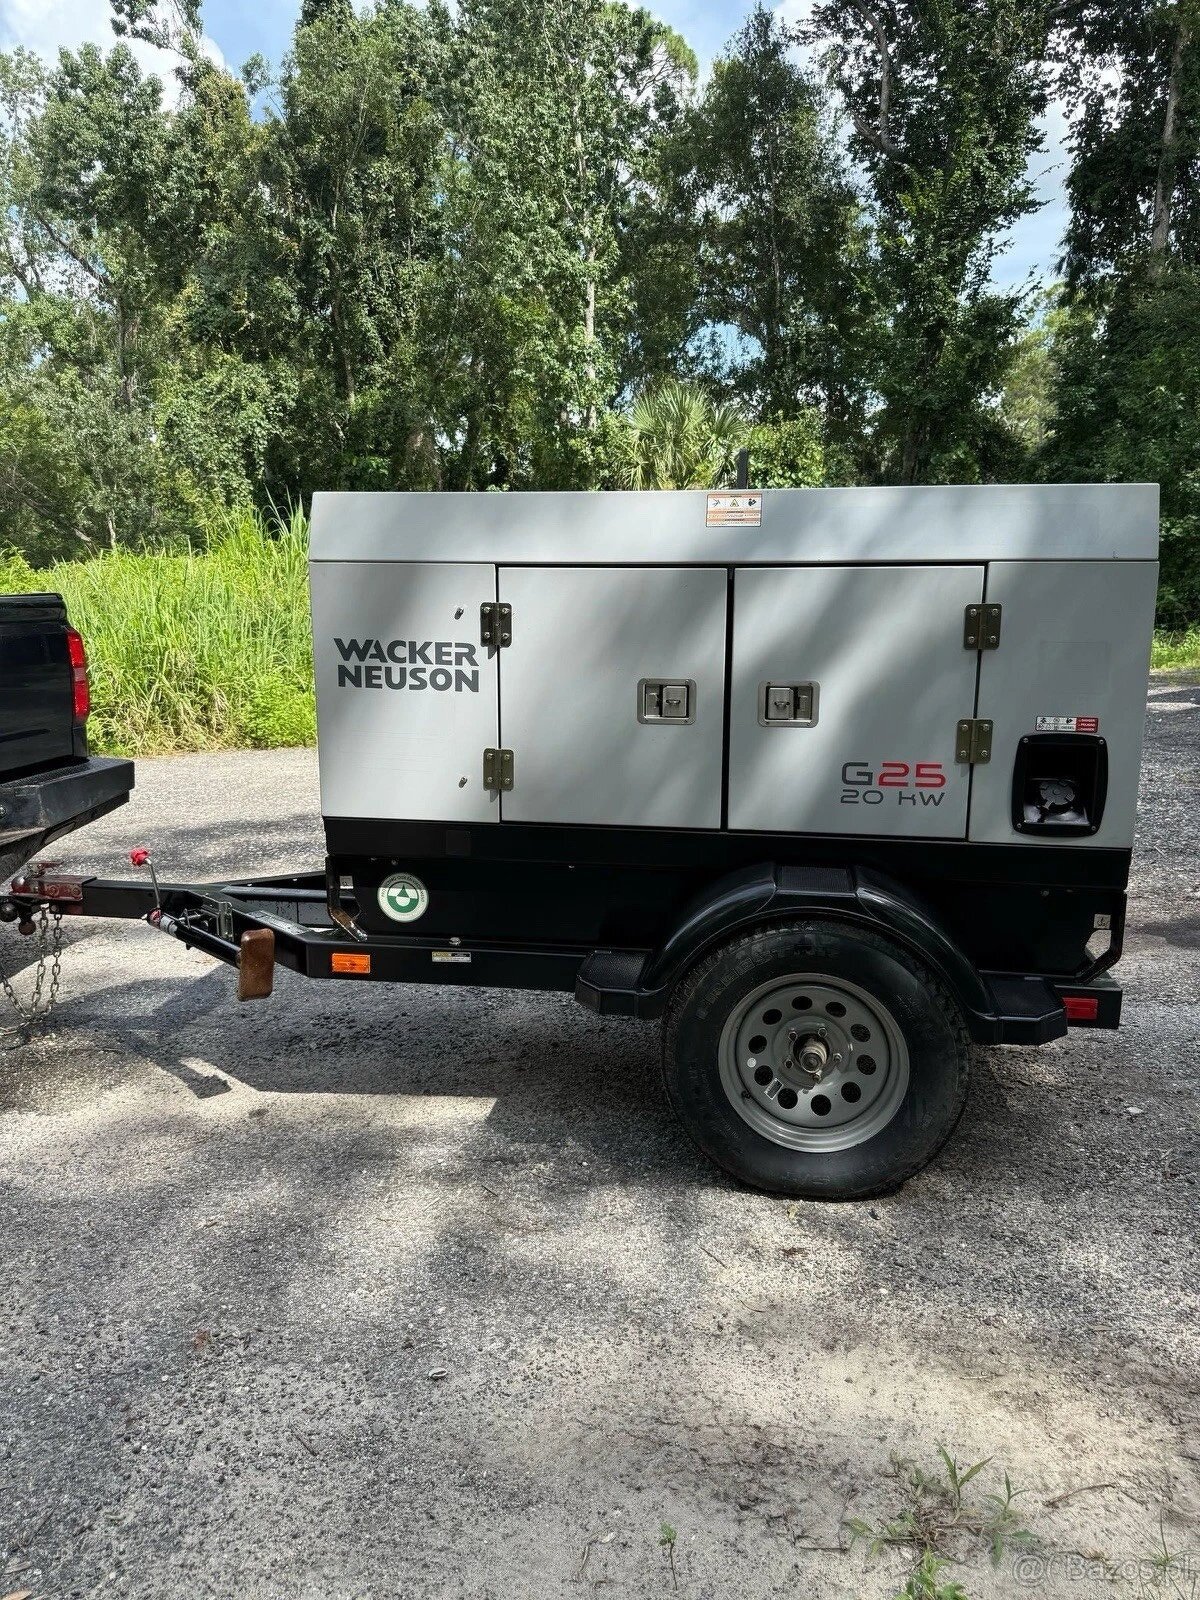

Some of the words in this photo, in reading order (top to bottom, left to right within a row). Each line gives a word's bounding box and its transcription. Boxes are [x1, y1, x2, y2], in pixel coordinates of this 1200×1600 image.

[333, 638, 480, 666] WACKER
[338, 665, 479, 692] NEUSON
[841, 761, 946, 788] G25
[840, 789, 884, 804] 20
